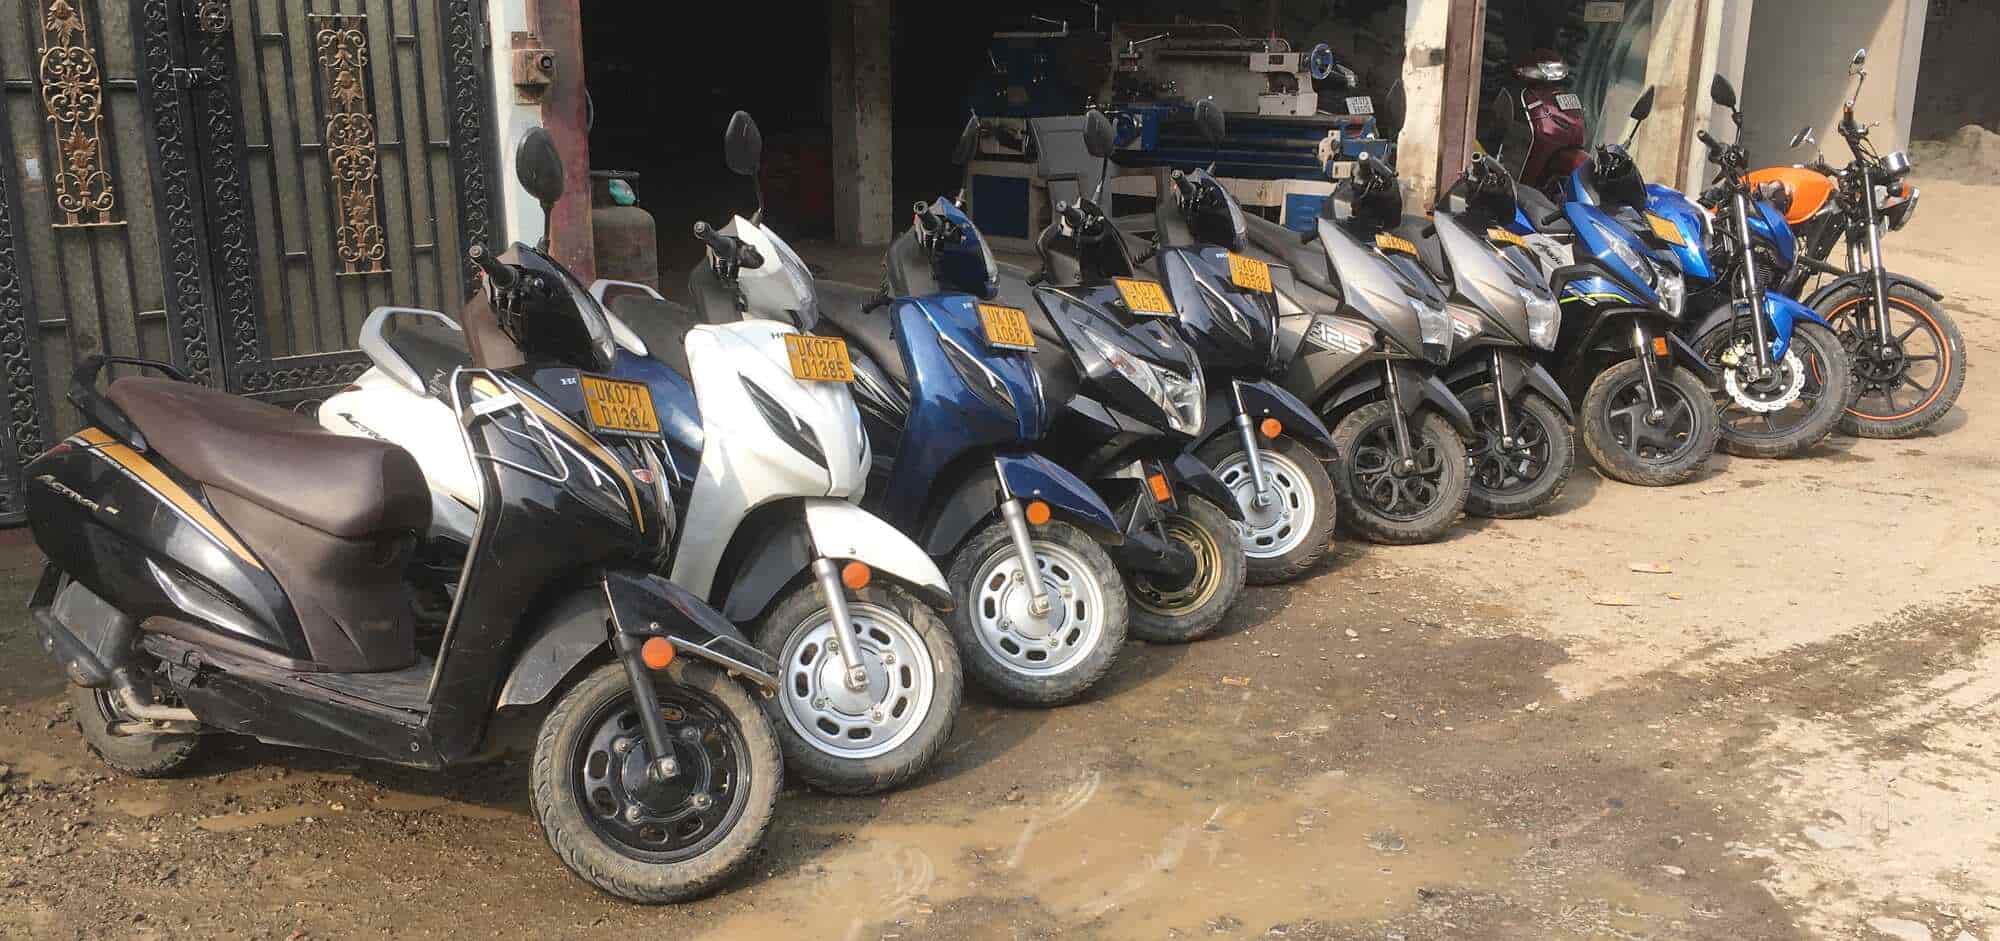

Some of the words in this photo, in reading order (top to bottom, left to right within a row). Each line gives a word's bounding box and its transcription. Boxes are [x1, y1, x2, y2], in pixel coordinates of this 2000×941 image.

[796, 338, 841, 359] UK07T
[800, 358, 849, 378] D1385
[593, 379, 643, 406] UK07T
